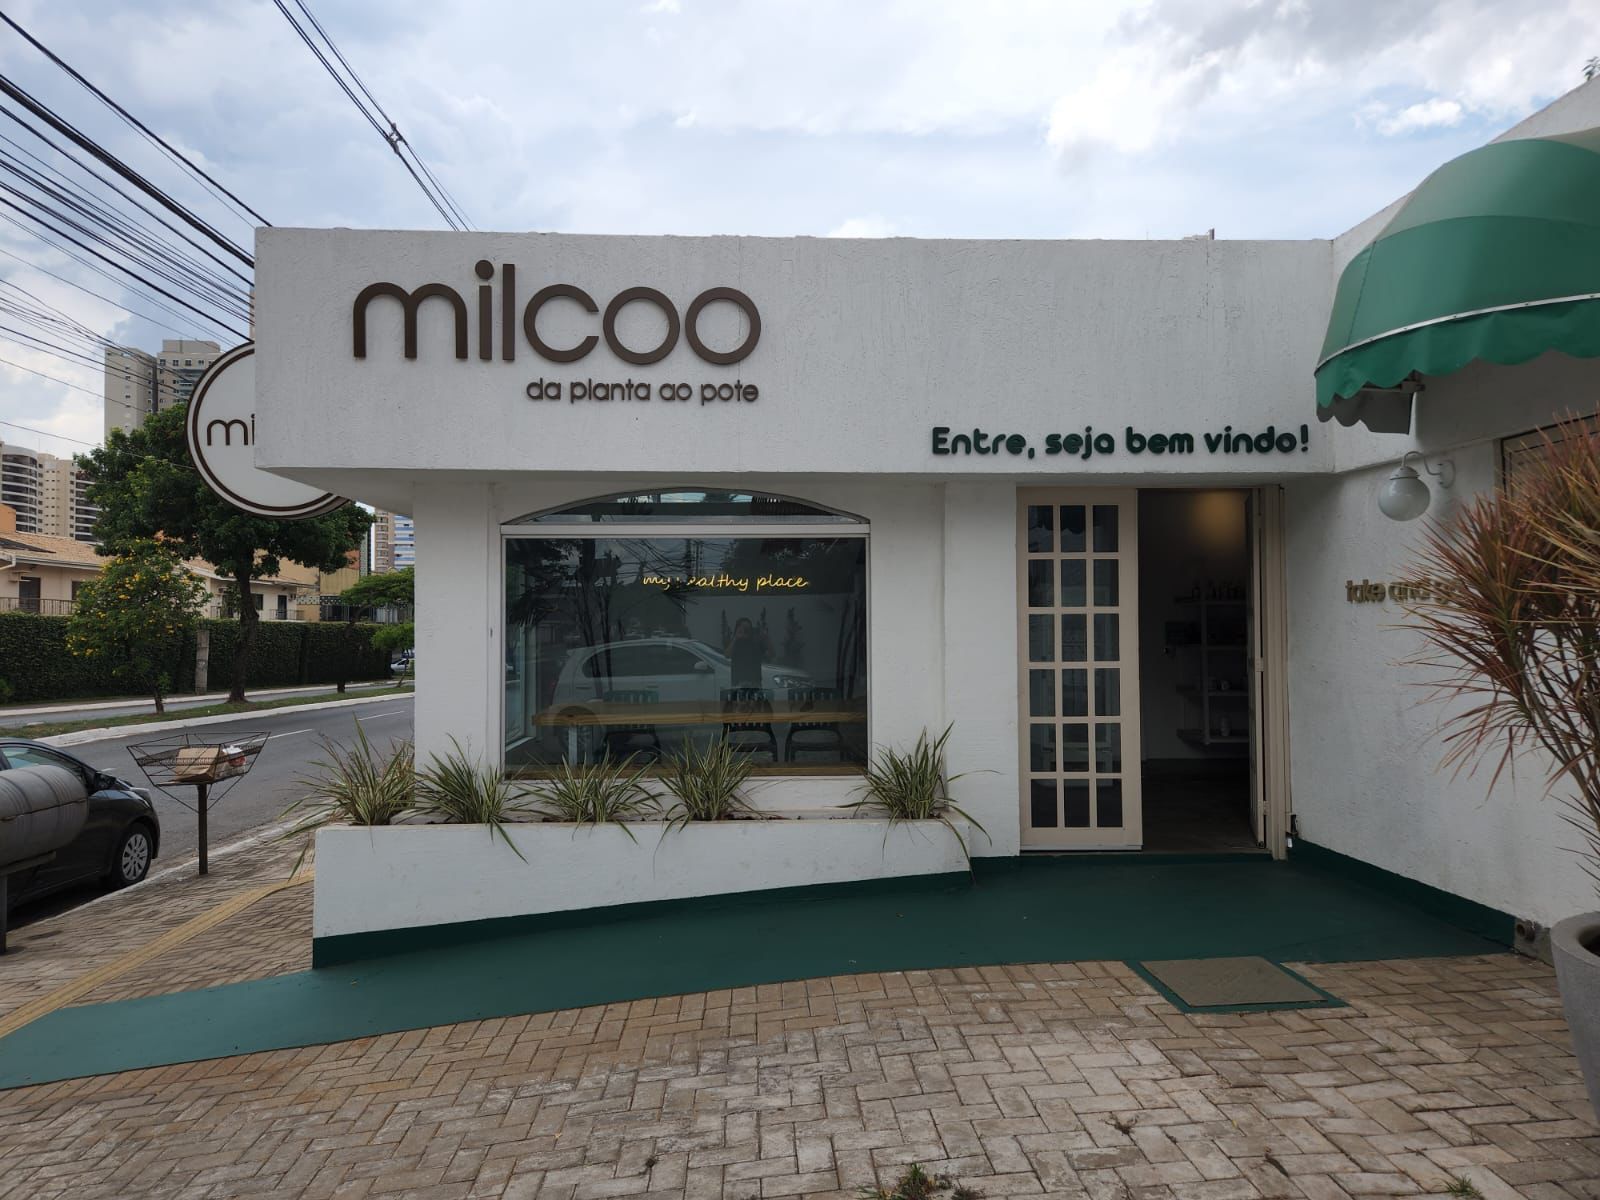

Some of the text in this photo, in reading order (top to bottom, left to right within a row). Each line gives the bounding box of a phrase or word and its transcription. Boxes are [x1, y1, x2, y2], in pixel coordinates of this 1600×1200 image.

[353, 260, 762, 365] milcoo
[526, 378, 760, 406] da planta ao pote
[932, 424, 1309, 460] Entre, seja bem vindo!
[676, 573, 749, 592] ealthy
[756, 573, 809, 591] place
[1345, 579, 1386, 604] take
